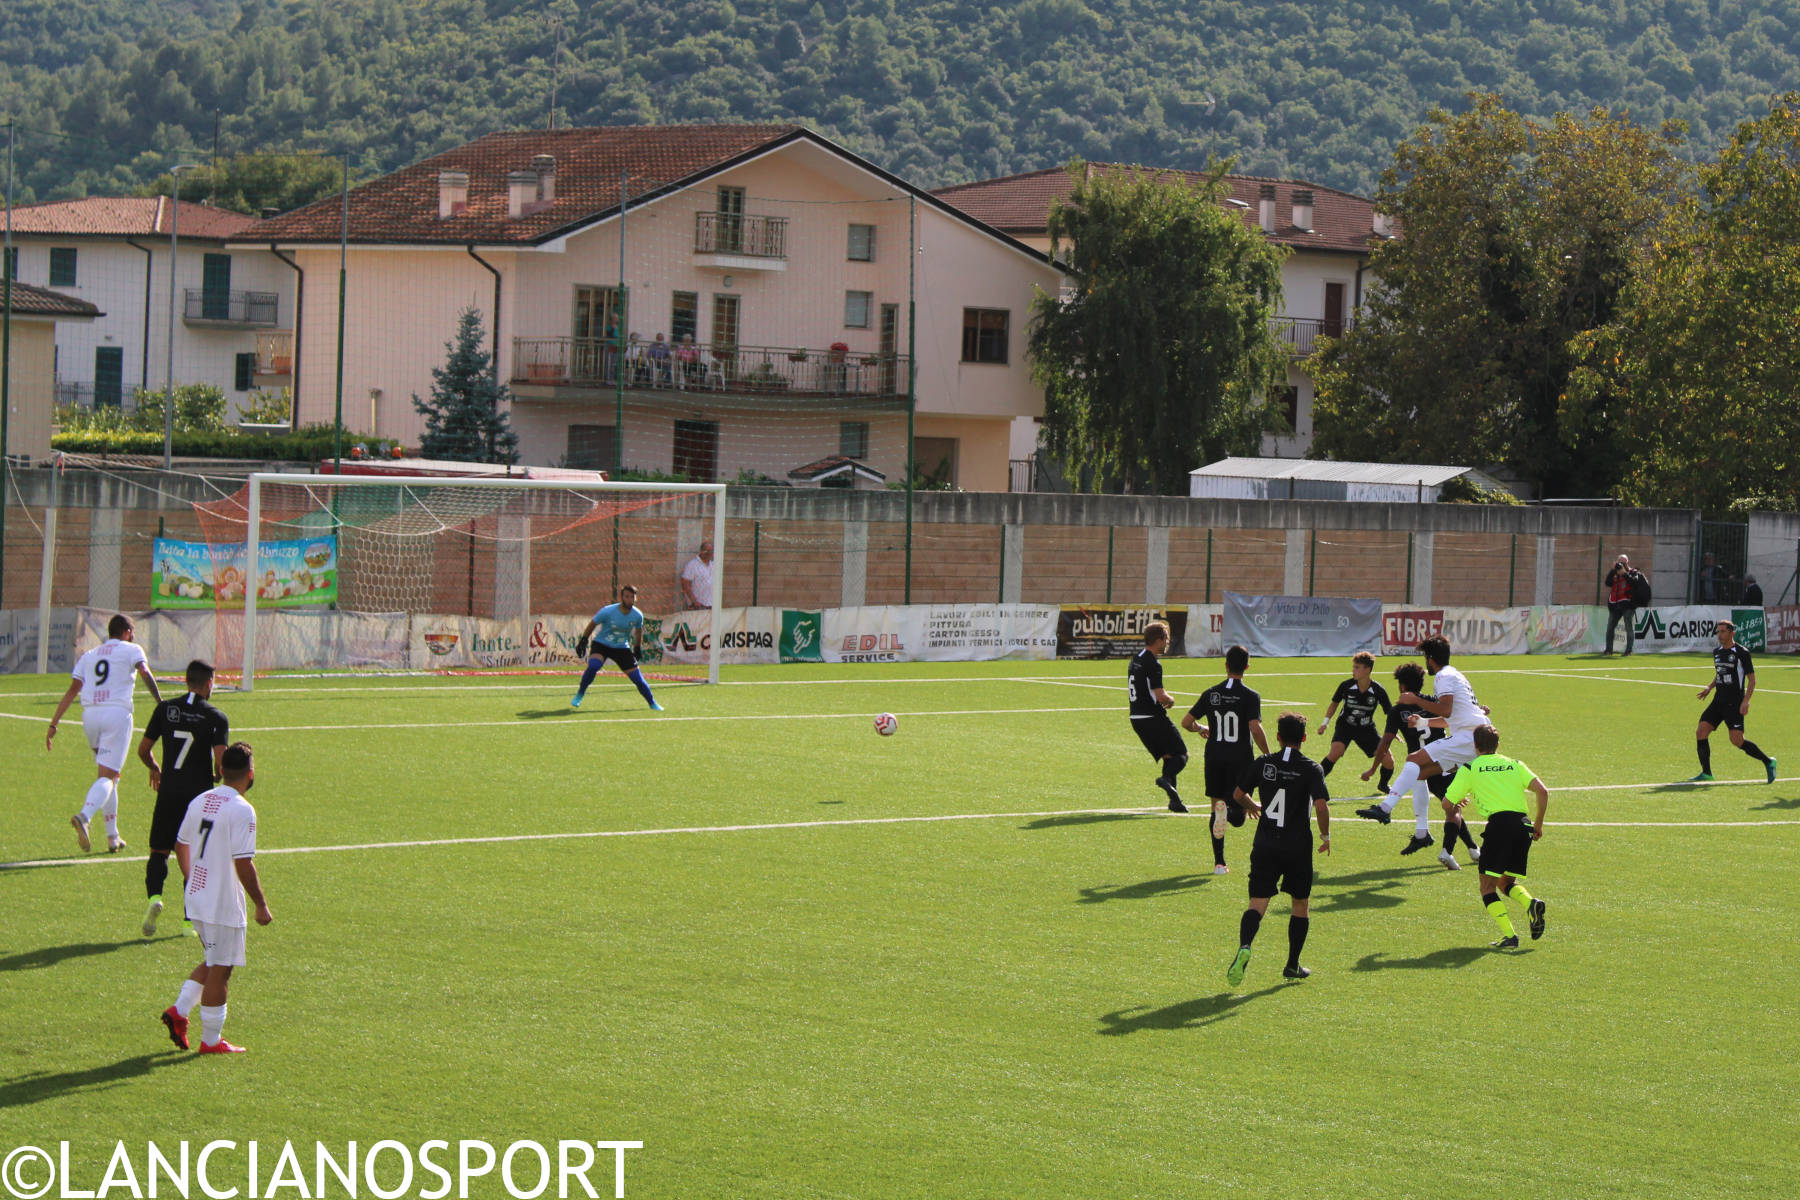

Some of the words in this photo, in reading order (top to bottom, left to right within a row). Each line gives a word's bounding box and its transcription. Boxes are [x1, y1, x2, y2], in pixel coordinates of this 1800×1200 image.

[930, 611, 966, 619] LAVORI
[1000, 610, 1010, 618] IN
[1015, 610, 1048, 618] GENERE
[1300, 601, 1310, 615] Di
[529, 621, 547, 648] &
[842, 634, 904, 650] EDIL
[1385, 618, 1441, 642] FIBRE
[1443, 619, 1505, 644] BUILD
[928, 639, 966, 648] IMPIANTI
[1040, 638, 1056, 646] GAS
[841, 653, 895, 663] SERVICE
[95, 659, 110, 686] 9
[1214, 710, 1239, 742] 10
[173, 730, 194, 769] 7
[1265, 788, 1286, 827] 4
[199, 818, 214, 859] 7
